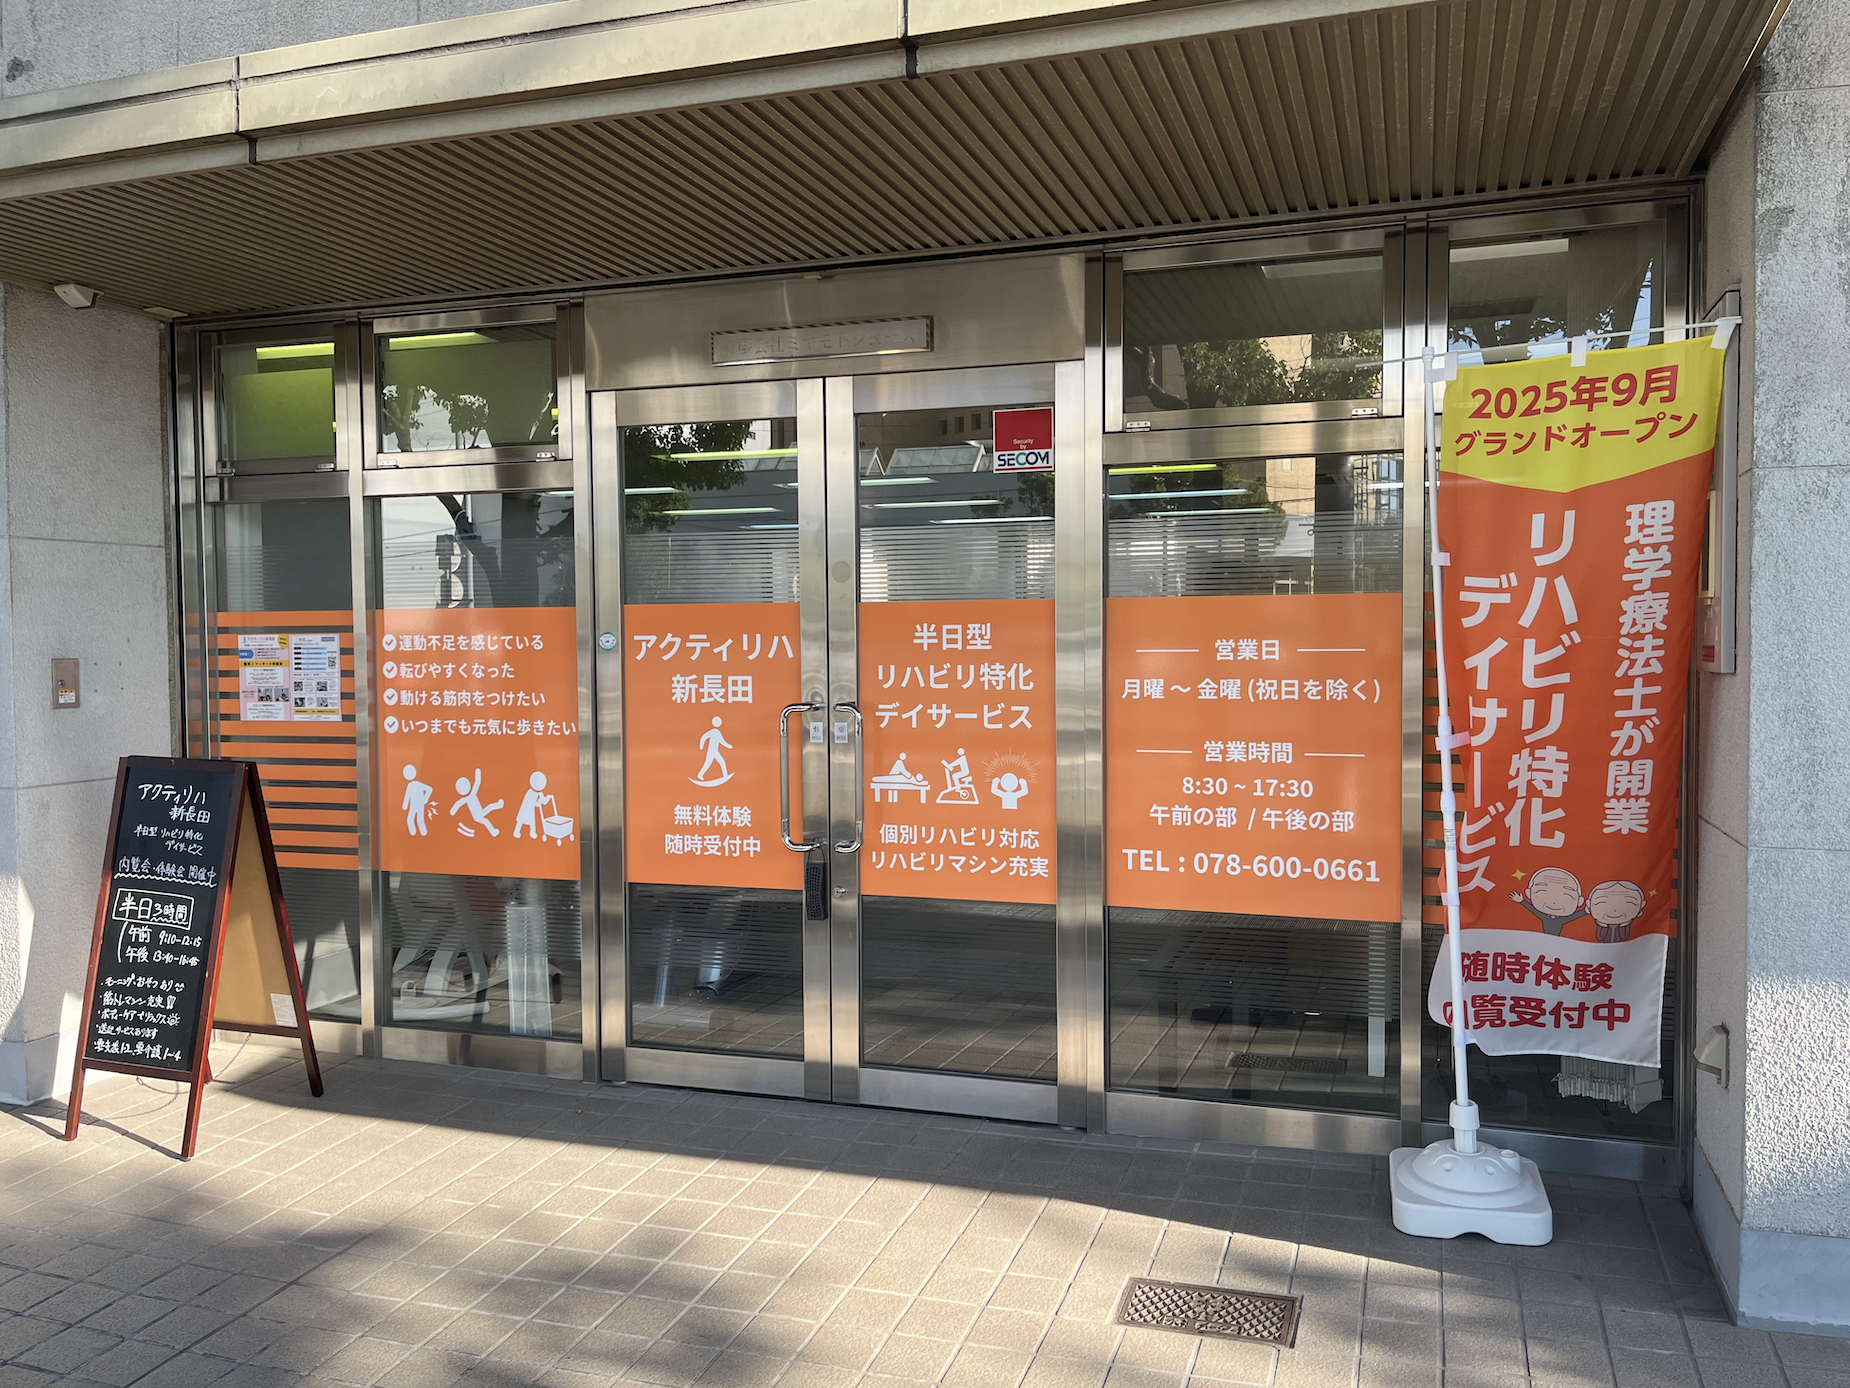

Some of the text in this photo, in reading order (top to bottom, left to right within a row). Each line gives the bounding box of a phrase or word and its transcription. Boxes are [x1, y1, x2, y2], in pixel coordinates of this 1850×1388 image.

[1468, 364, 1680, 420] 2025年9月
[1012, 437, 1034, 445] Security
[1454, 411, 1699, 457] グランドオープン
[997, 451, 1050, 467] SECOM
[398, 633, 544, 652] 運動不足を感じている
[632, 632, 794, 662] アクティリハ
[912, 622, 993, 652] 半日型
[1214, 638, 1281, 661] 営業日
[399, 662, 515, 679] 転びやすくなった
[876, 662, 1035, 691] リハビリ特化
[1503, 509, 1582, 849] リハビリ特化
[1602, 499, 1676, 835] 理学療法士が開業
[399, 689, 546, 707] 動ける筋肉をつけたい
[671, 673, 753, 704] 新長田
[1121, 678, 1165, 700] 月曜
[1197, 678, 1242, 700] 金曜
[1247, 678, 1381, 704] (祝日を除く)
[401, 718, 577, 736] いつまでも元気に歩きたい
[874, 701, 1033, 730] デイサービス
[1457, 571, 1518, 893] デイサービス
[1203, 740, 1294, 764] 営業時間
[137, 782, 207, 806] アクティリハ
[1181, 776, 1229, 796] 8:30
[1252, 777, 1314, 798] 17:30
[168, 805, 211, 824] 新長田
[673, 803, 752, 828] 無料体験
[1149, 803, 1238, 829] 午前の部
[1261, 807, 1355, 833] 午後の部
[133, 823, 205, 842] 半日型 リハビリ特化
[664, 833, 762, 858] 随時受付中
[878, 823, 1041, 850] 個別リハビリ対応
[870, 850, 1050, 878] リハビリマシン充実
[1121, 848, 1170, 873] TEL
[1192, 851, 1381, 883] 078-600-0661
[118, 892, 188, 922] 半日3時間
[128, 924, 153, 943] 午前
[125, 945, 150, 963] 午後
[1460, 950, 1616, 993] 随時体験
